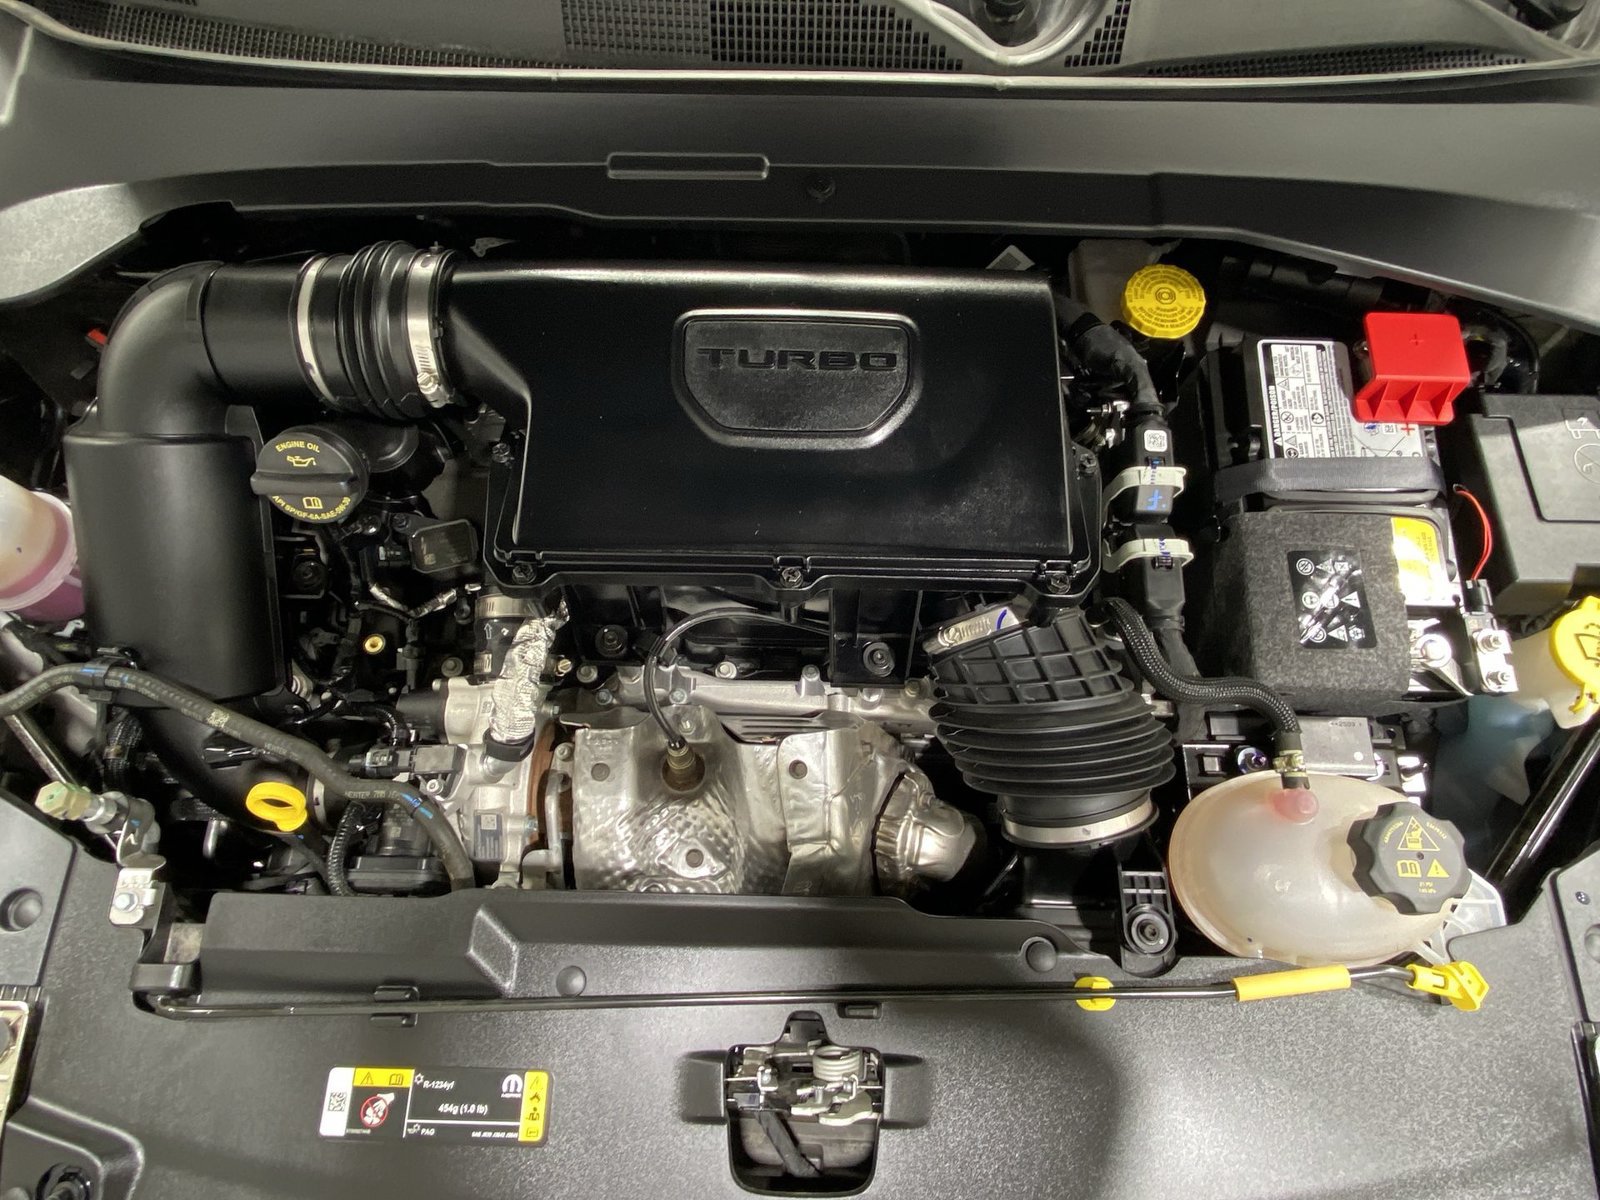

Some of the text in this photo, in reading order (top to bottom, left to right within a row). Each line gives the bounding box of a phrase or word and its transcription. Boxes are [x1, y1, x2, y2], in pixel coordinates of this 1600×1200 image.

[697, 348, 897, 371] TURBO
[275, 440, 321, 453] ENGINE OIL
[272, 495, 285, 508] API
[423, 1080, 455, 1091] R-1234yf
[438, 1104, 488, 1116] 454g (1.0 lb)
